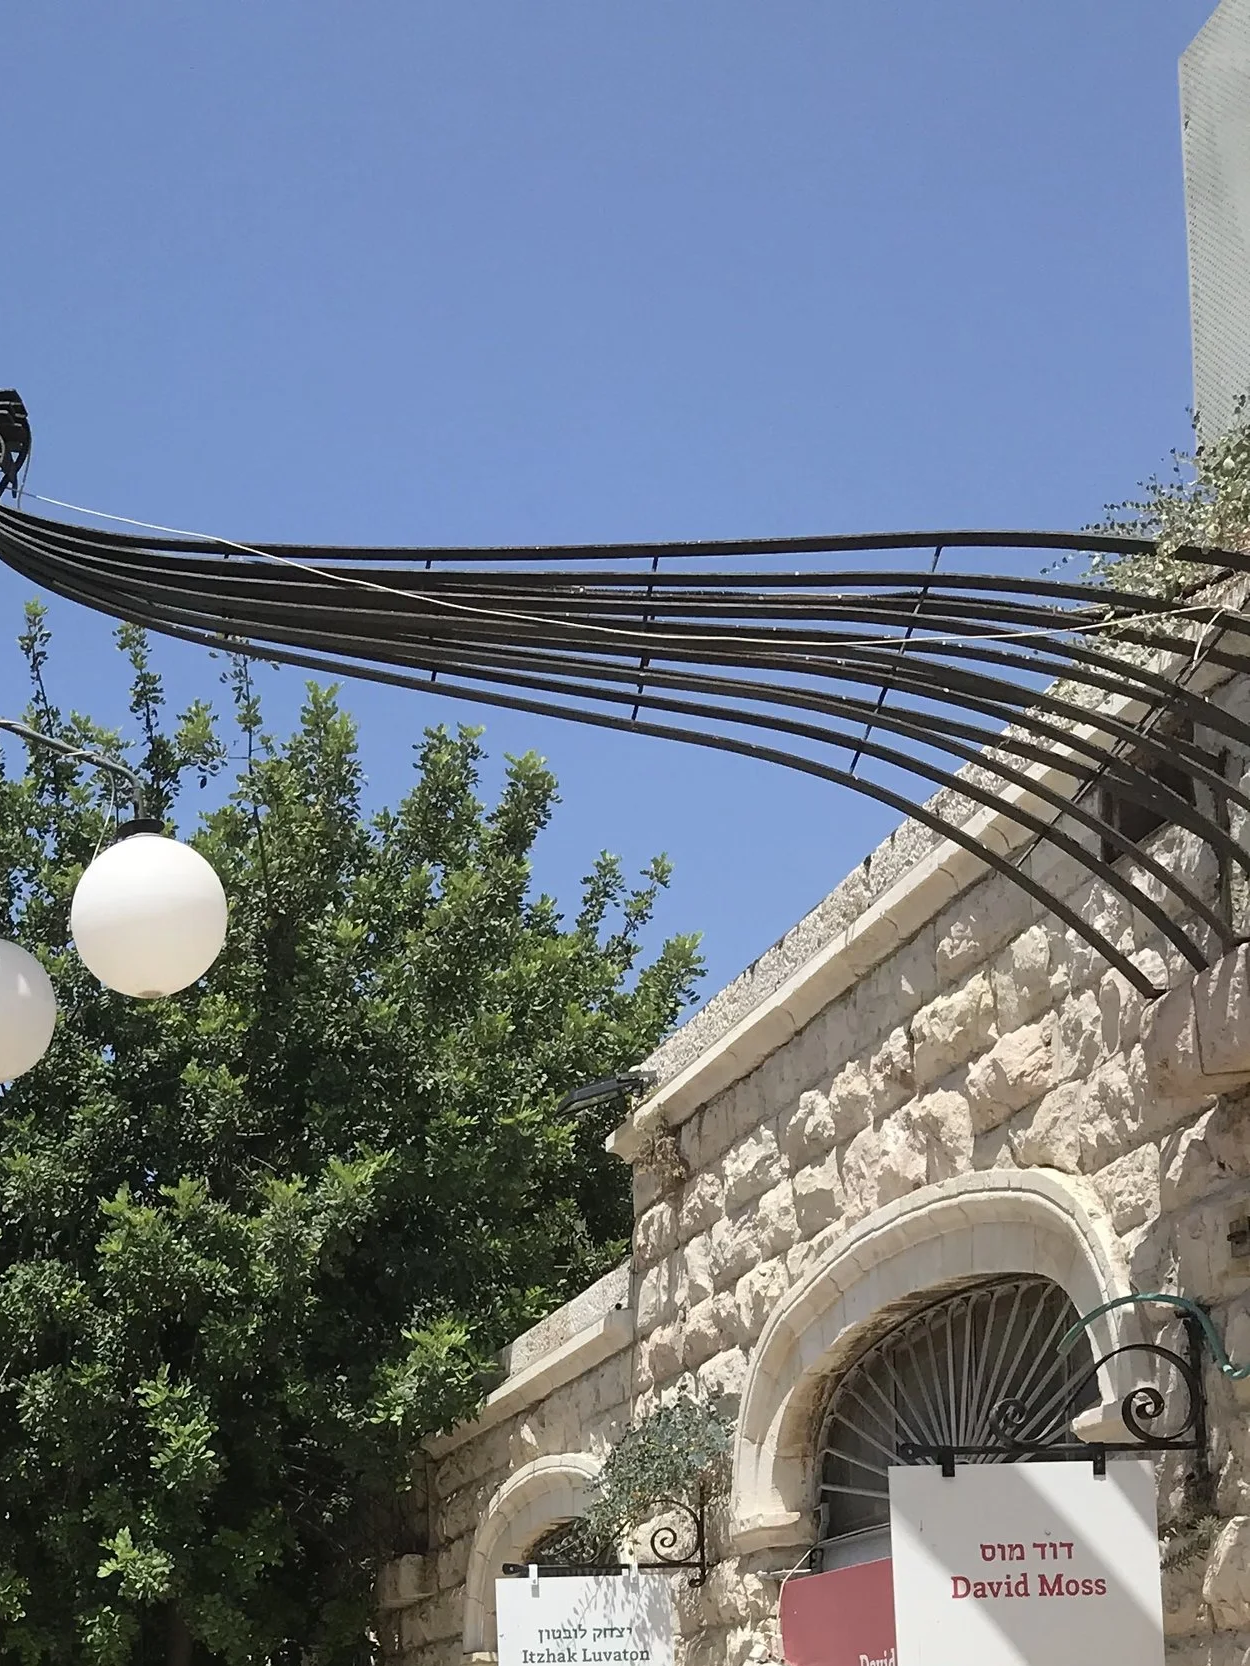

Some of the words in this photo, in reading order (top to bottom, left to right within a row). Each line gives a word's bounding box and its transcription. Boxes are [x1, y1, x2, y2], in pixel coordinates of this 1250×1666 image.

[980, 1543, 1026, 1562] מוס
[1032, 1541, 1075, 1560] דוד
[951, 1573, 1031, 1599] David
[1038, 1573, 1107, 1597] Moss
[538, 1624, 587, 1643] לובטון
[592, 1626, 633, 1642] יצחק
[522, 1648, 578, 1664] Itzhak
[582, 1648, 651, 1663] Luvaton
